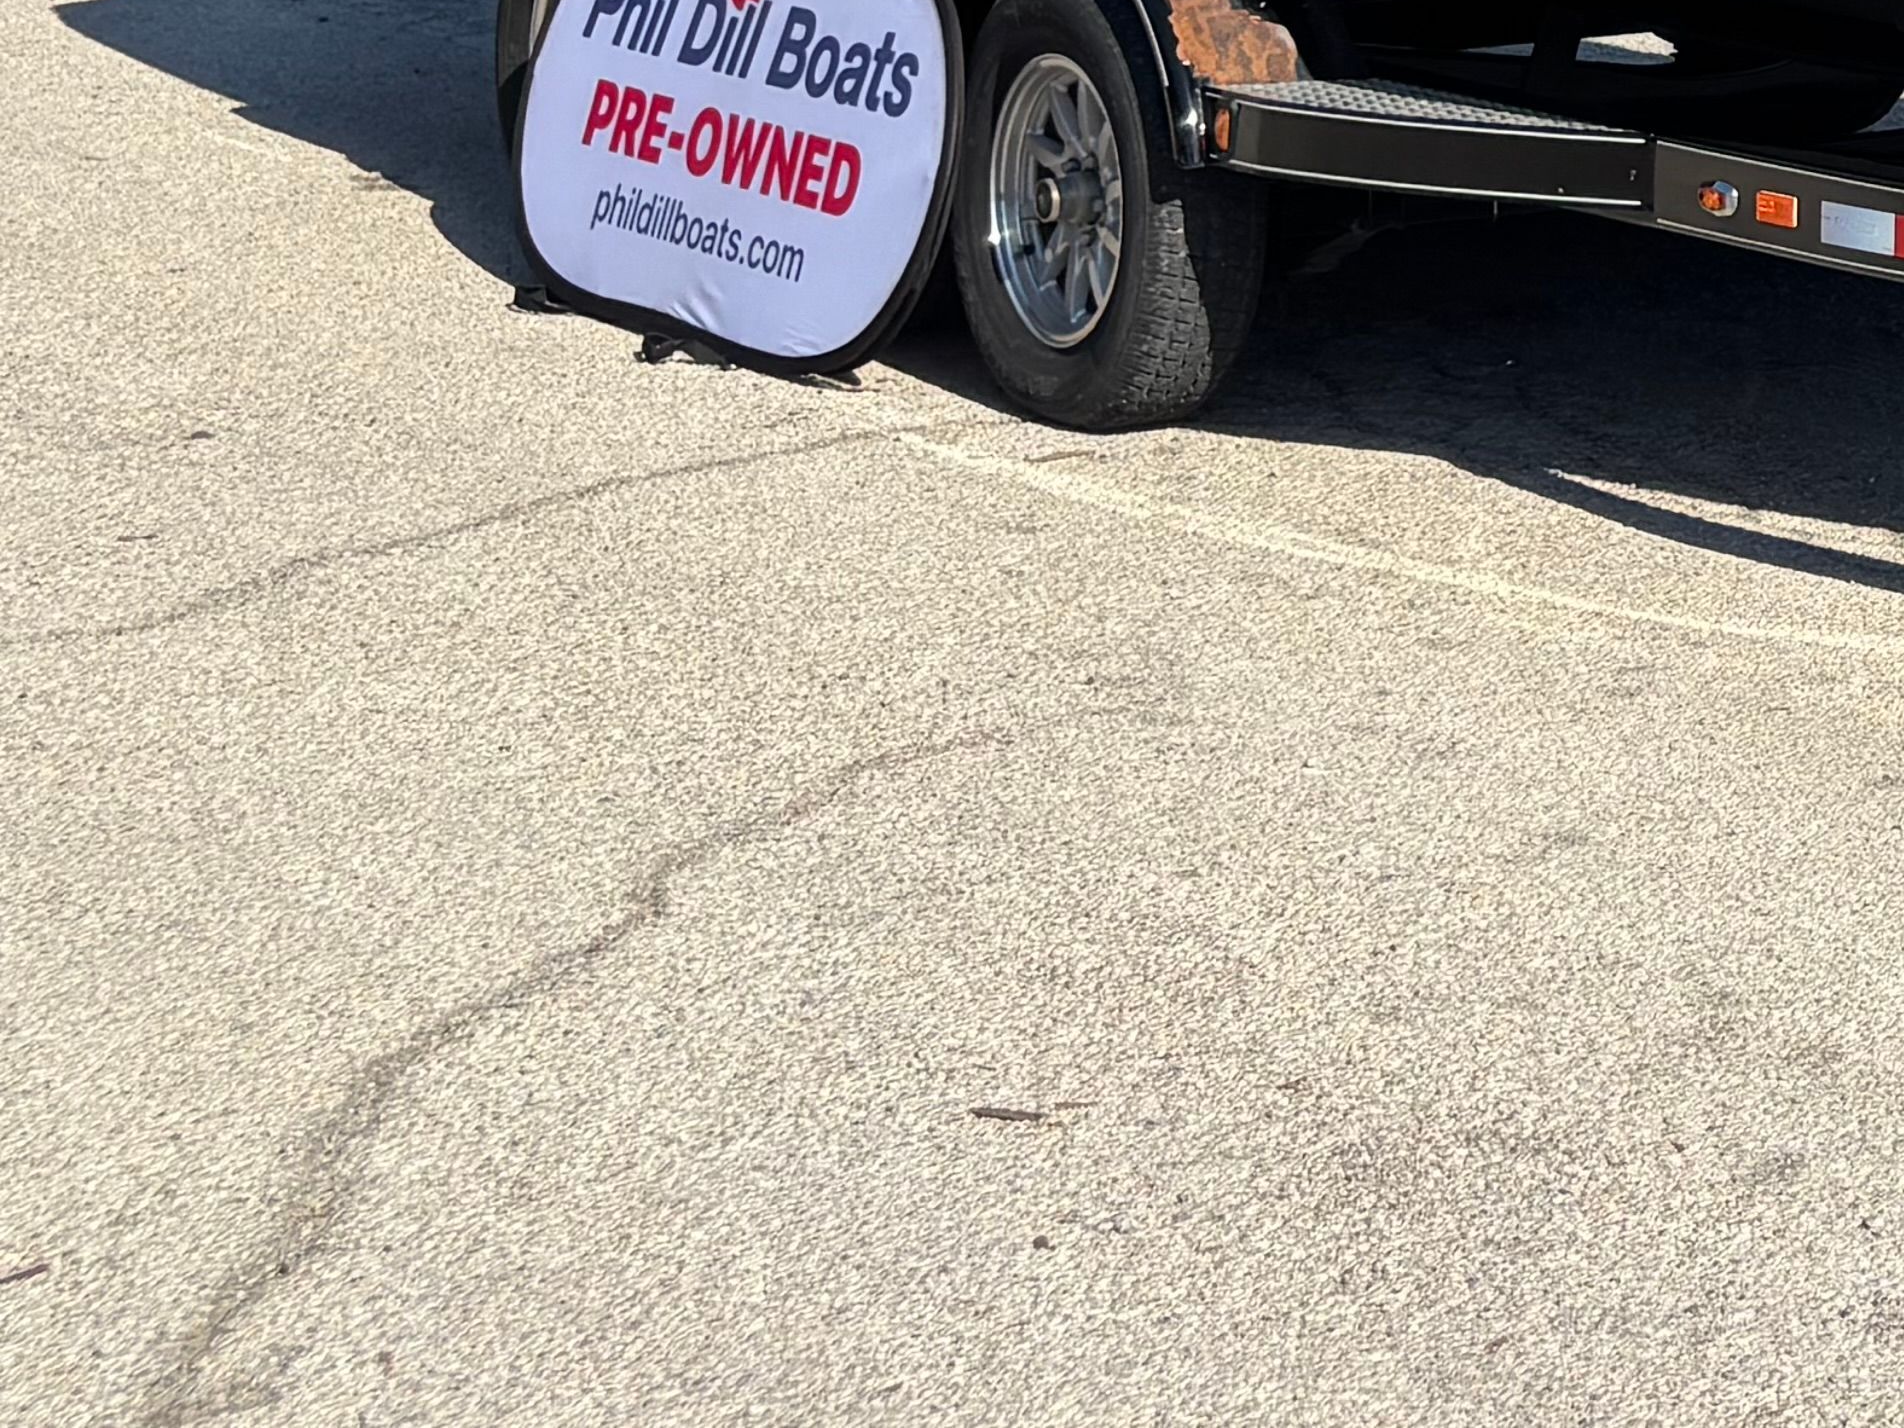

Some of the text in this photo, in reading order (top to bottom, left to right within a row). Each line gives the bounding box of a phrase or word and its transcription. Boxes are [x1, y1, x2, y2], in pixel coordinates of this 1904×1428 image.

[765, 6, 920, 118] Boats
[581, 78, 862, 217] PRE-OWNED
[590, 183, 805, 283] phildillboats.com
